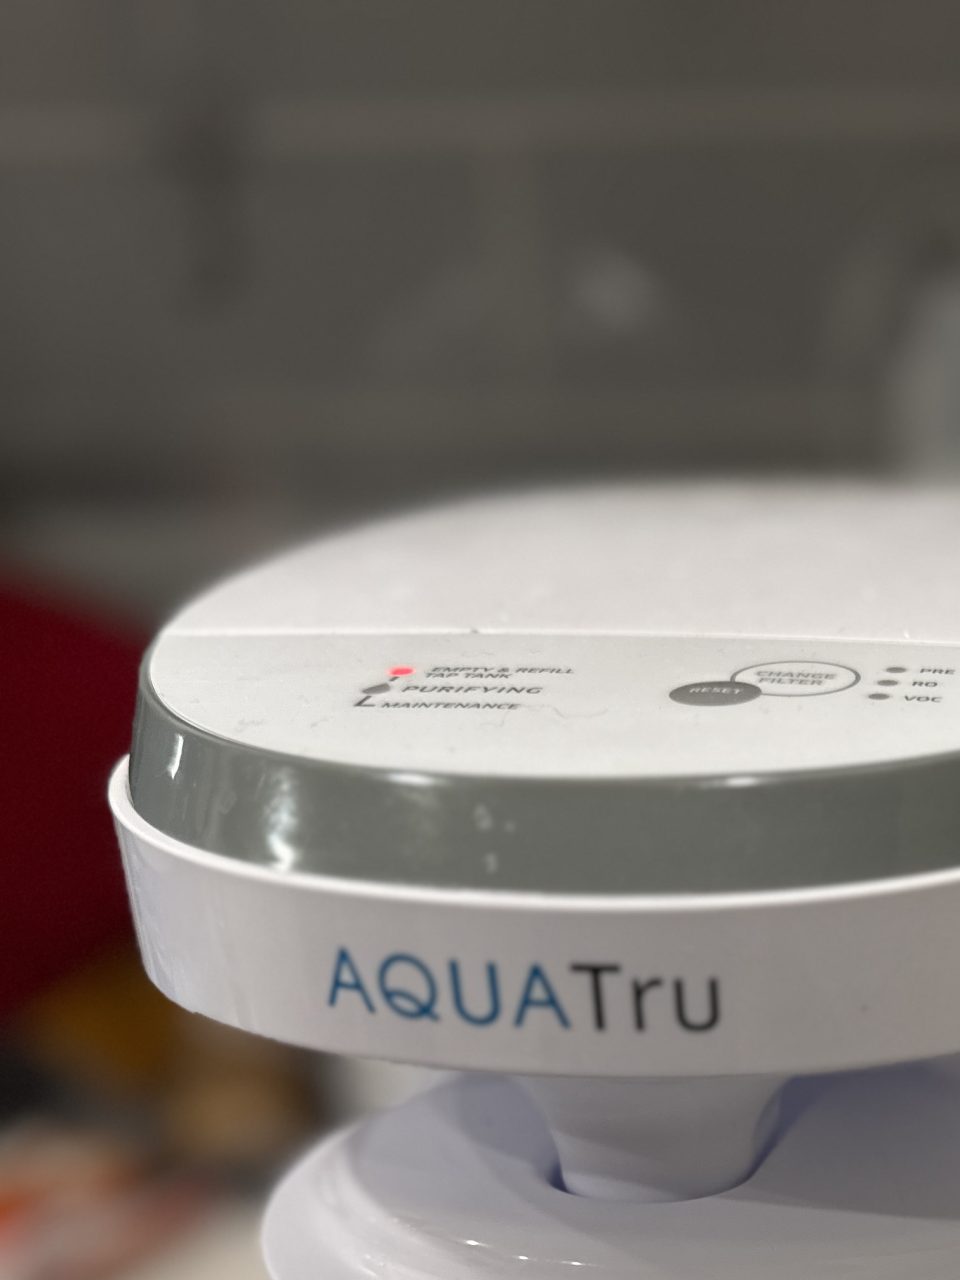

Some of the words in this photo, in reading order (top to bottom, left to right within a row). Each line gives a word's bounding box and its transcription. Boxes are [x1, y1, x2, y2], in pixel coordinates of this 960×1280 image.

[515, 667, 575, 675] REFILL
[755, 669, 837, 680] CHANGE
[919, 667, 956, 676] PRE
[464, 672, 513, 680] TANK
[757, 677, 823, 686] FILTER
[911, 680, 938, 688] RO
[400, 685, 544, 695] PURIFYING
[688, 686, 744, 695] RESET
[904, 694, 943, 704] VOC
[380, 702, 522, 711] MAINTENANCE
[327, 946, 721, 1033] AQUATru
